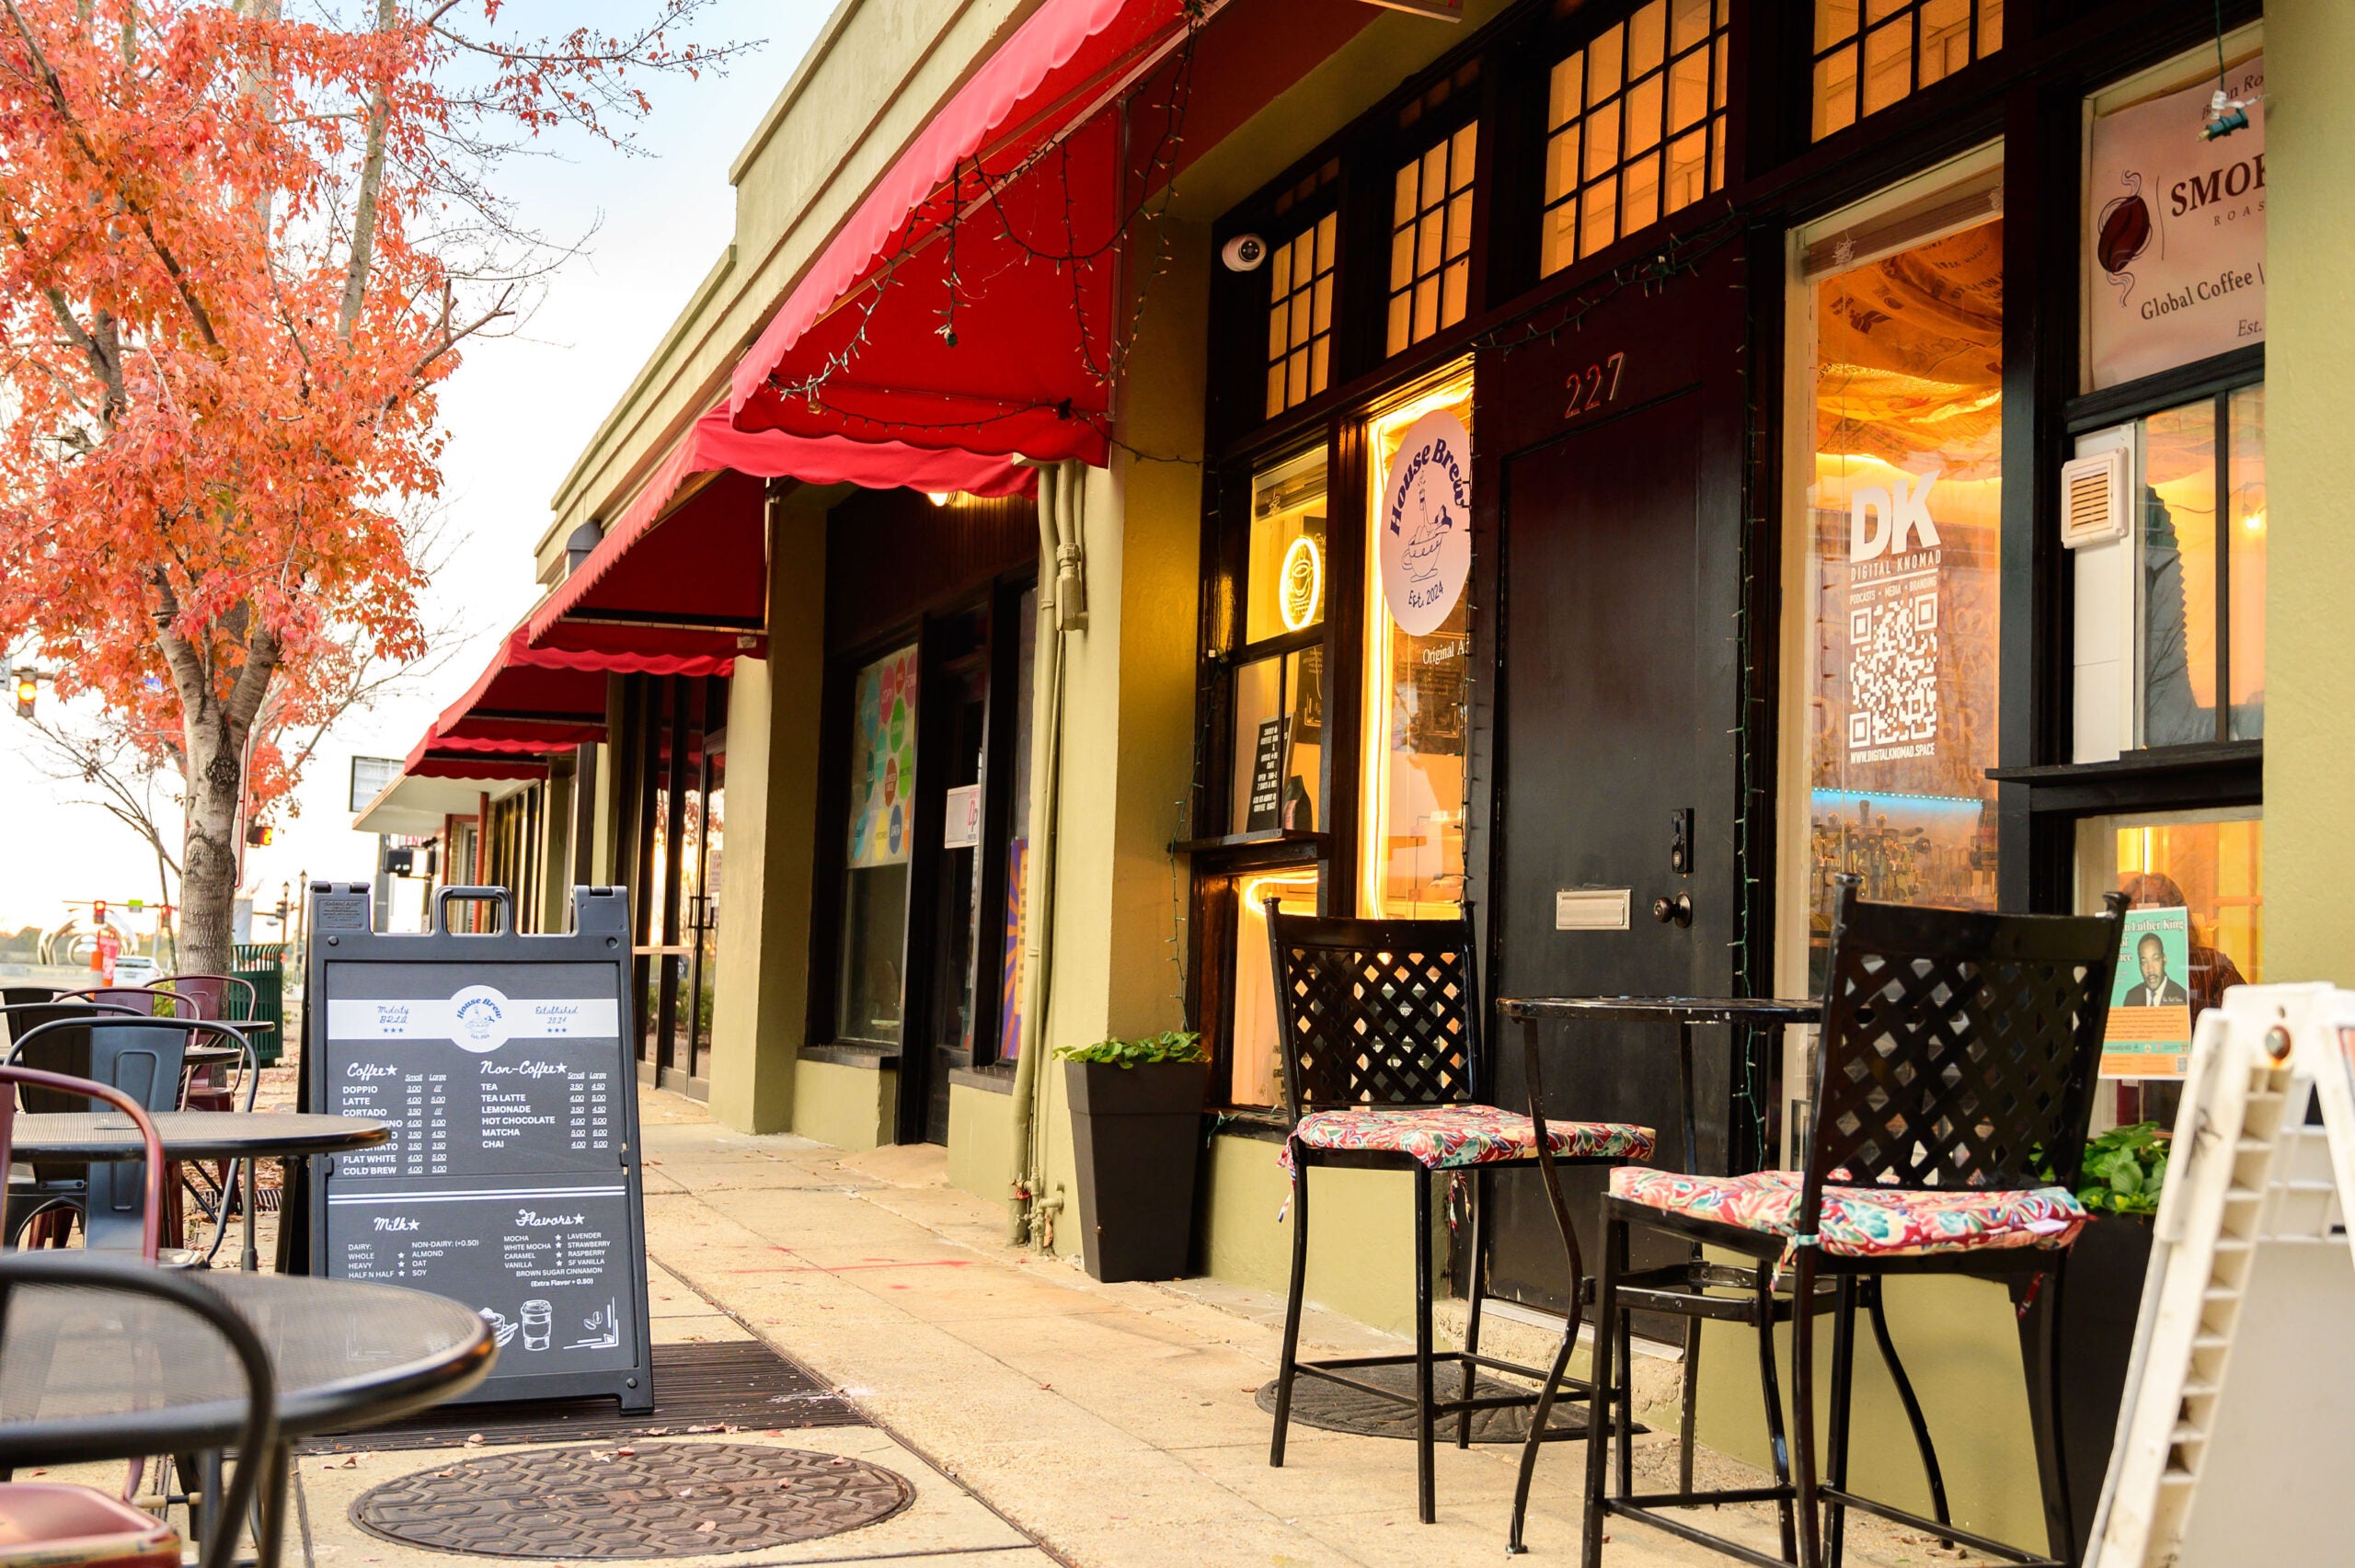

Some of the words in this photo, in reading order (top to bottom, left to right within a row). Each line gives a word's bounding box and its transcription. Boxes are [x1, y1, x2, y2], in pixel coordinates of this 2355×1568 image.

[2141, 286, 2195, 320] Global
[2197, 270, 2253, 301] Coffee
[2237, 319, 2262, 337] Est.
[1565, 351, 1624, 418] 227
[1390, 444, 1430, 538] House
[1431, 438, 1465, 508] Brew
[1850, 469, 1941, 563] DK
[1851, 560, 1891, 581] DIGITAL
[1897, 549, 1941, 572] KNOMAD
[1408, 589, 1424, 608] Est.
[1426, 580, 1443, 605] 2024
[1850, 590, 1876, 605] PODCASTS
[1885, 585, 1901, 598] MEDIA
[1910, 576, 1936, 591] BRANDING
[1422, 641, 1454, 665] Original
[1850, 743, 1936, 764] WWW.DIGITALKNOMAD.SPACE
[2131, 919, 2160, 932] Luther
[2163, 918, 2184, 932] King
[456, 998, 482, 1019] House
[482, 998, 501, 1019] Brew
[535, 1006, 579, 1014] Established
[347, 1062, 386, 1082] Coffee
[480, 1060, 557, 1079] Non-Coffee
[405, 1073, 423, 1082] Small
[429, 1073, 447, 1082] Large
[568, 1071, 585, 1080] Small
[589, 1071, 607, 1080] Large
[591, 1082, 605, 1091] 4.50
[342, 1097, 371, 1105] LATTE
[407, 1096, 422, 1104] 4.00
[481, 1094, 499, 1103] TEA
[500, 1093, 526, 1102] LATTE
[569, 1094, 585, 1103] 4.00
[592, 1094, 606, 1103] 5.00
[342, 1108, 387, 1116] CORTADO
[481, 1105, 532, 1114] LEMONADE
[570, 1106, 585, 1115] 3.50
[592, 1105, 606, 1114] 4.50
[407, 1119, 422, 1127] 4.00
[482, 1117, 501, 1126] HOT
[502, 1116, 556, 1125] CHOCOLATE
[570, 1117, 585, 1126] 4.00
[592, 1117, 607, 1126] 5.00
[408, 1131, 422, 1139] 3.50
[431, 1130, 446, 1139] 4.50
[482, 1128, 521, 1137] MATCHA
[570, 1129, 586, 1138] 5.00
[354, 1143, 398, 1151] CHIATO
[482, 1140, 505, 1149] CHAI
[570, 1141, 587, 1150] 4.00
[592, 1140, 608, 1149] 5.00
[342, 1155, 365, 1163] FLAT
[408, 1154, 423, 1162] 4.00
[431, 1153, 447, 1162] 5.00
[342, 1167, 369, 1175] COLD
[370, 1166, 397, 1174] BREW
[408, 1166, 423, 1174] 4.00
[431, 1165, 447, 1173] 5.00
[515, 1208, 574, 1227] Flavors
[373, 1217, 409, 1231] Milk
[567, 1232, 602, 1241] LAVENDER
[411, 1241, 454, 1249] NON-DAIRY:
[455, 1239, 479, 1247] (+0.50)
[503, 1243, 525, 1252] WHITE
[567, 1241, 611, 1249] STRAWBERRY
[411, 1250, 443, 1258] ALMOND
[349, 1262, 373, 1270] HEAVY
[375, 1270, 395, 1278] HALF
